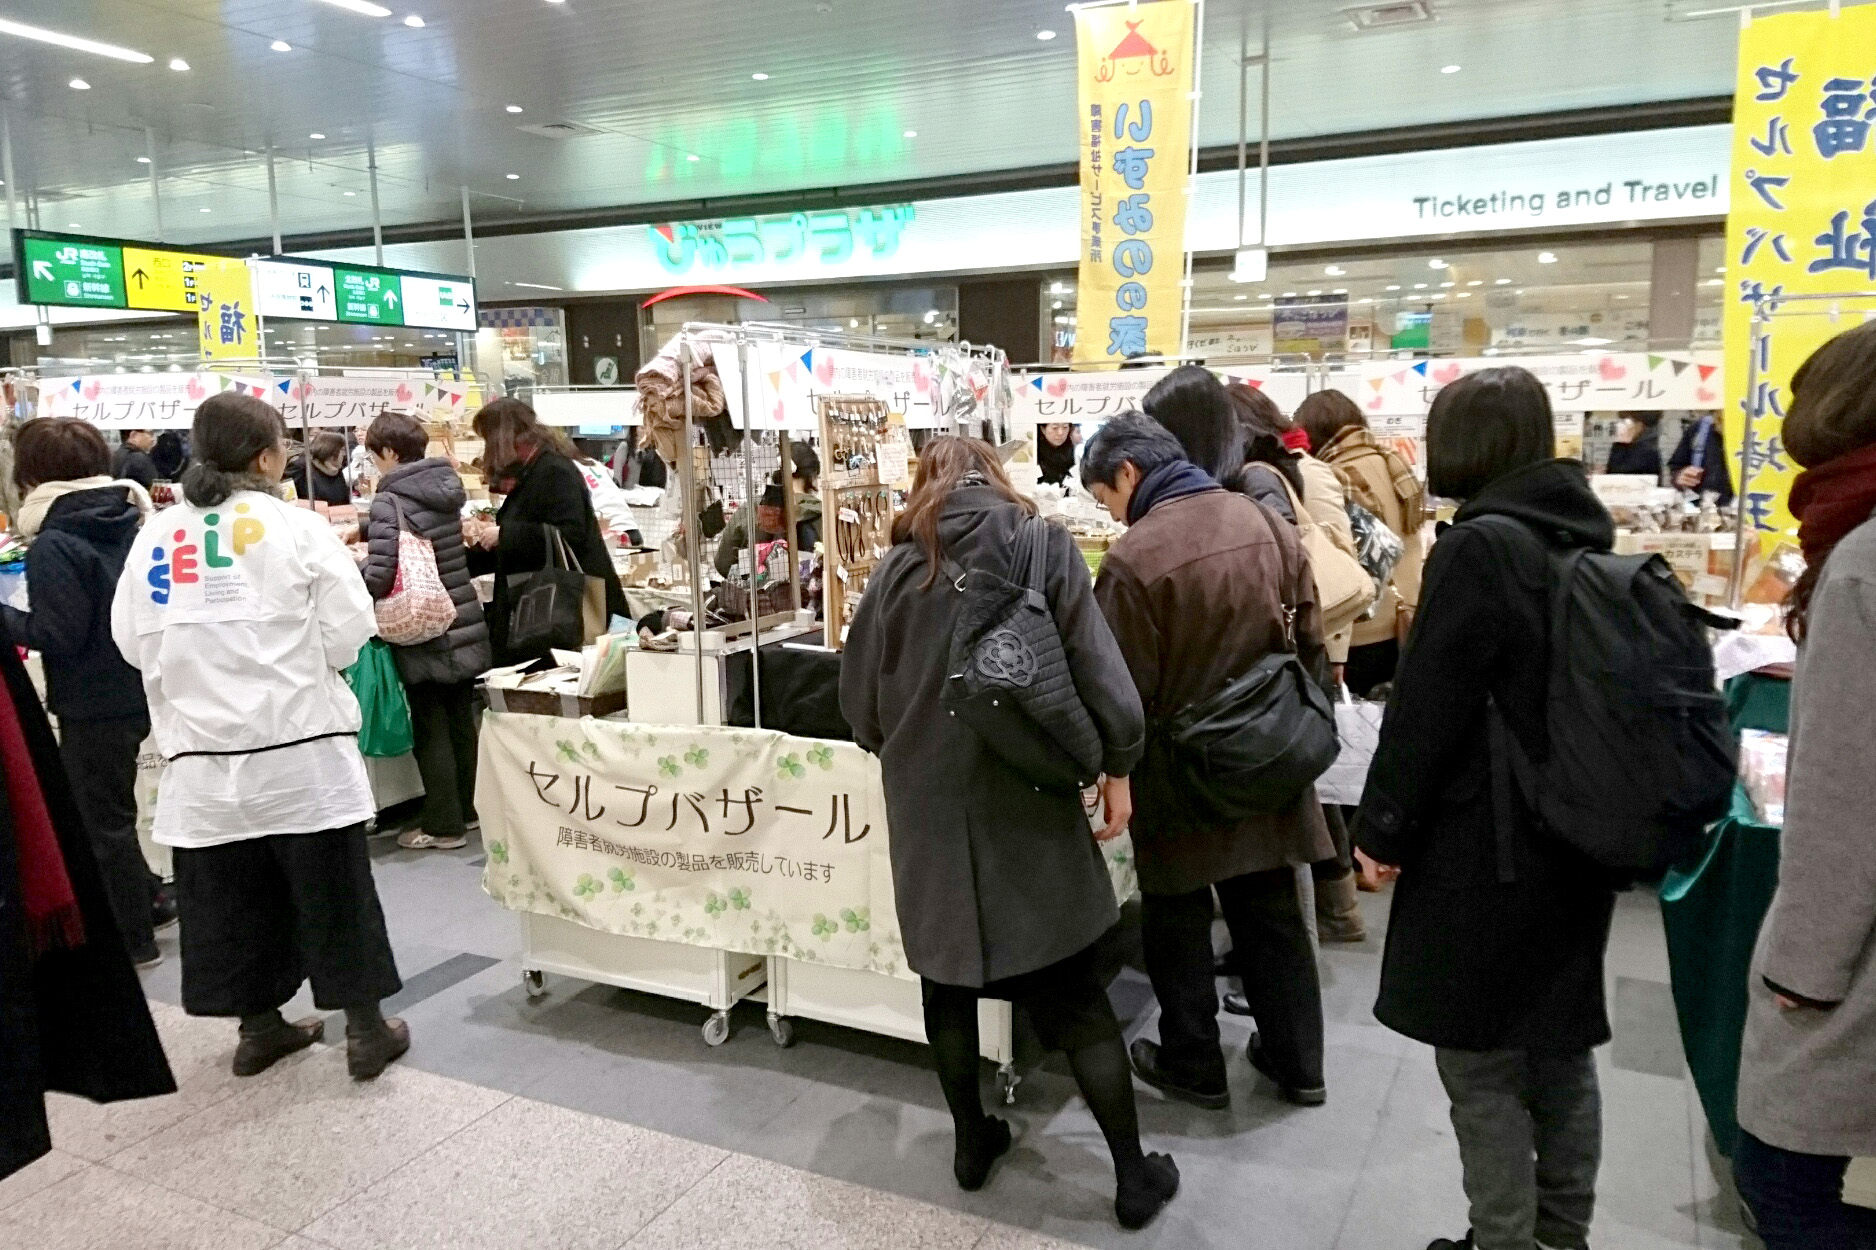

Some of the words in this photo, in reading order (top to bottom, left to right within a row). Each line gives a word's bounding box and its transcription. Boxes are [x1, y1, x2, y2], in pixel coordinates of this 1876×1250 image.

[1413, 190, 1546, 217] Ticketing
[1556, 182, 1613, 209] and
[1622, 174, 1718, 203] Travel
[56, 247, 79, 261] JR
[365, 277, 380, 288] JR
[147, 503, 265, 605] SELP
[204, 574, 231, 582] Support
[525, 760, 871, 844] セルプバザール
[556, 826, 836, 884] 障害者就労施設の製品を販売しています
